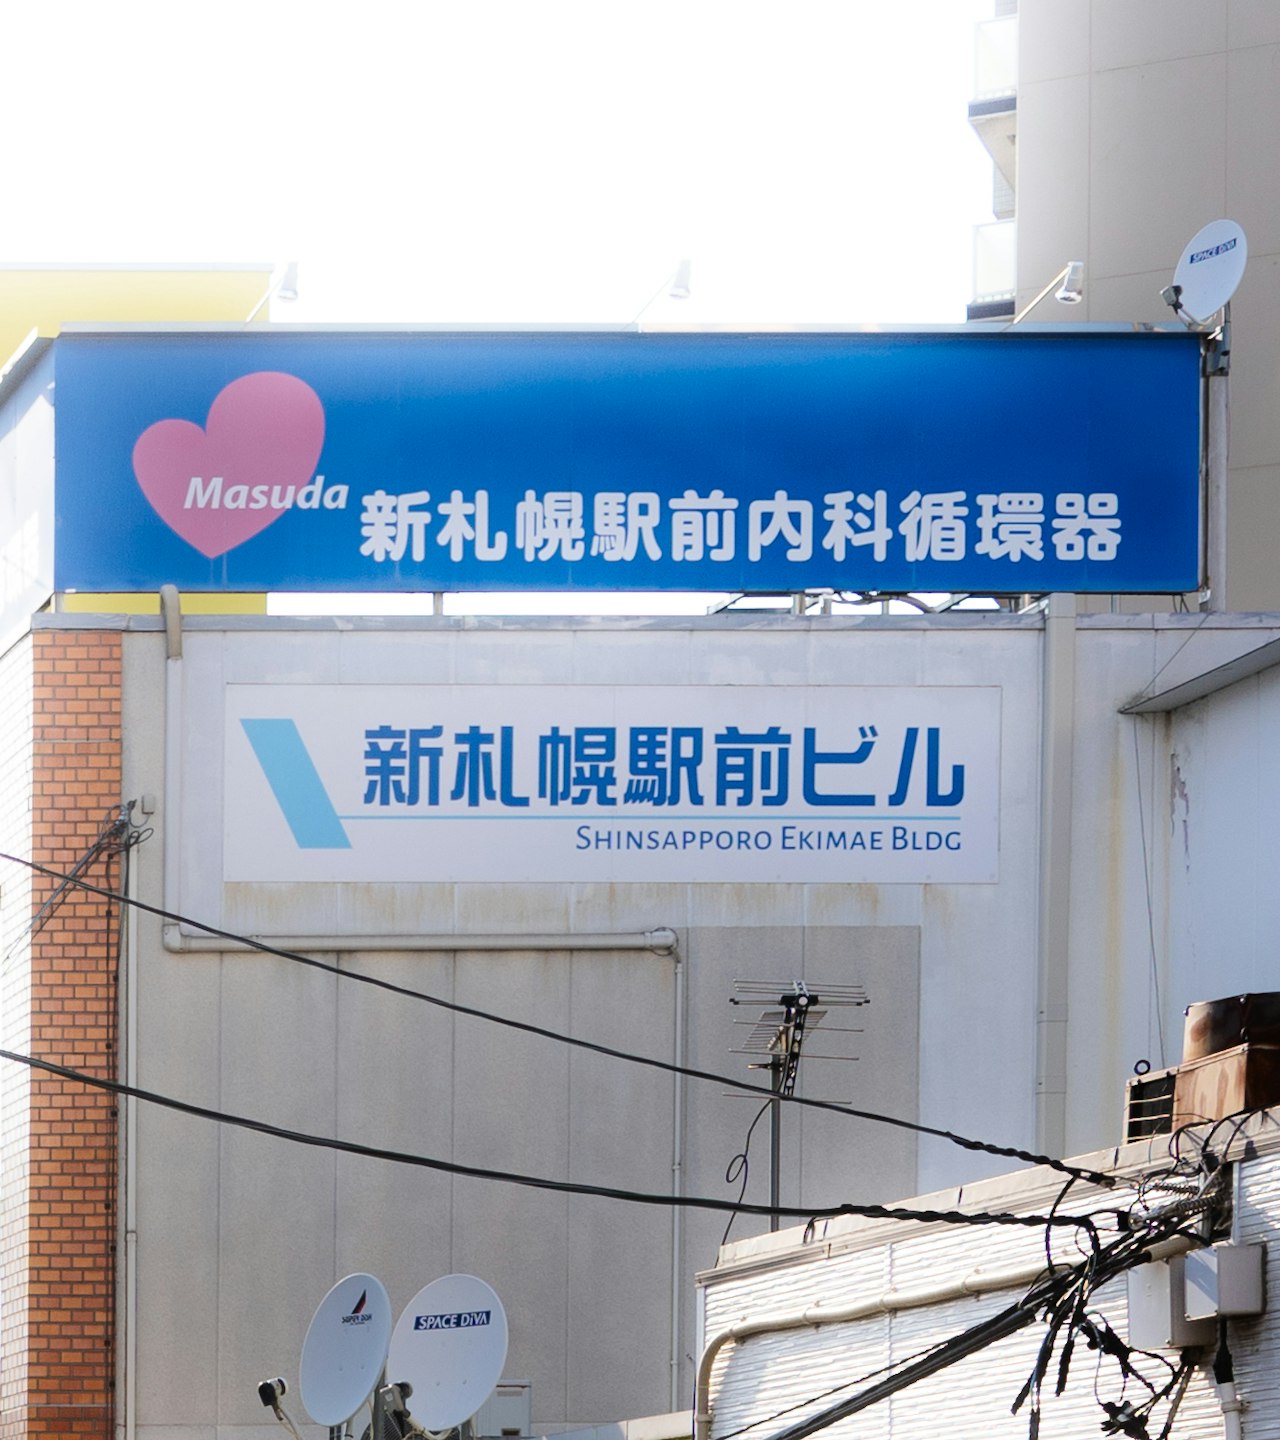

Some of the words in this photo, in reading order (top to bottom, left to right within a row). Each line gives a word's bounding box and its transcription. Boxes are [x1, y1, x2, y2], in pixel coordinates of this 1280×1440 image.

[183, 473, 349, 516] Masuda
[359, 488, 1123, 565] 新札幌駅前内科循環器
[363, 723, 966, 809] 新札幌駅前ビル
[419, 1314, 458, 1330] SPACE
